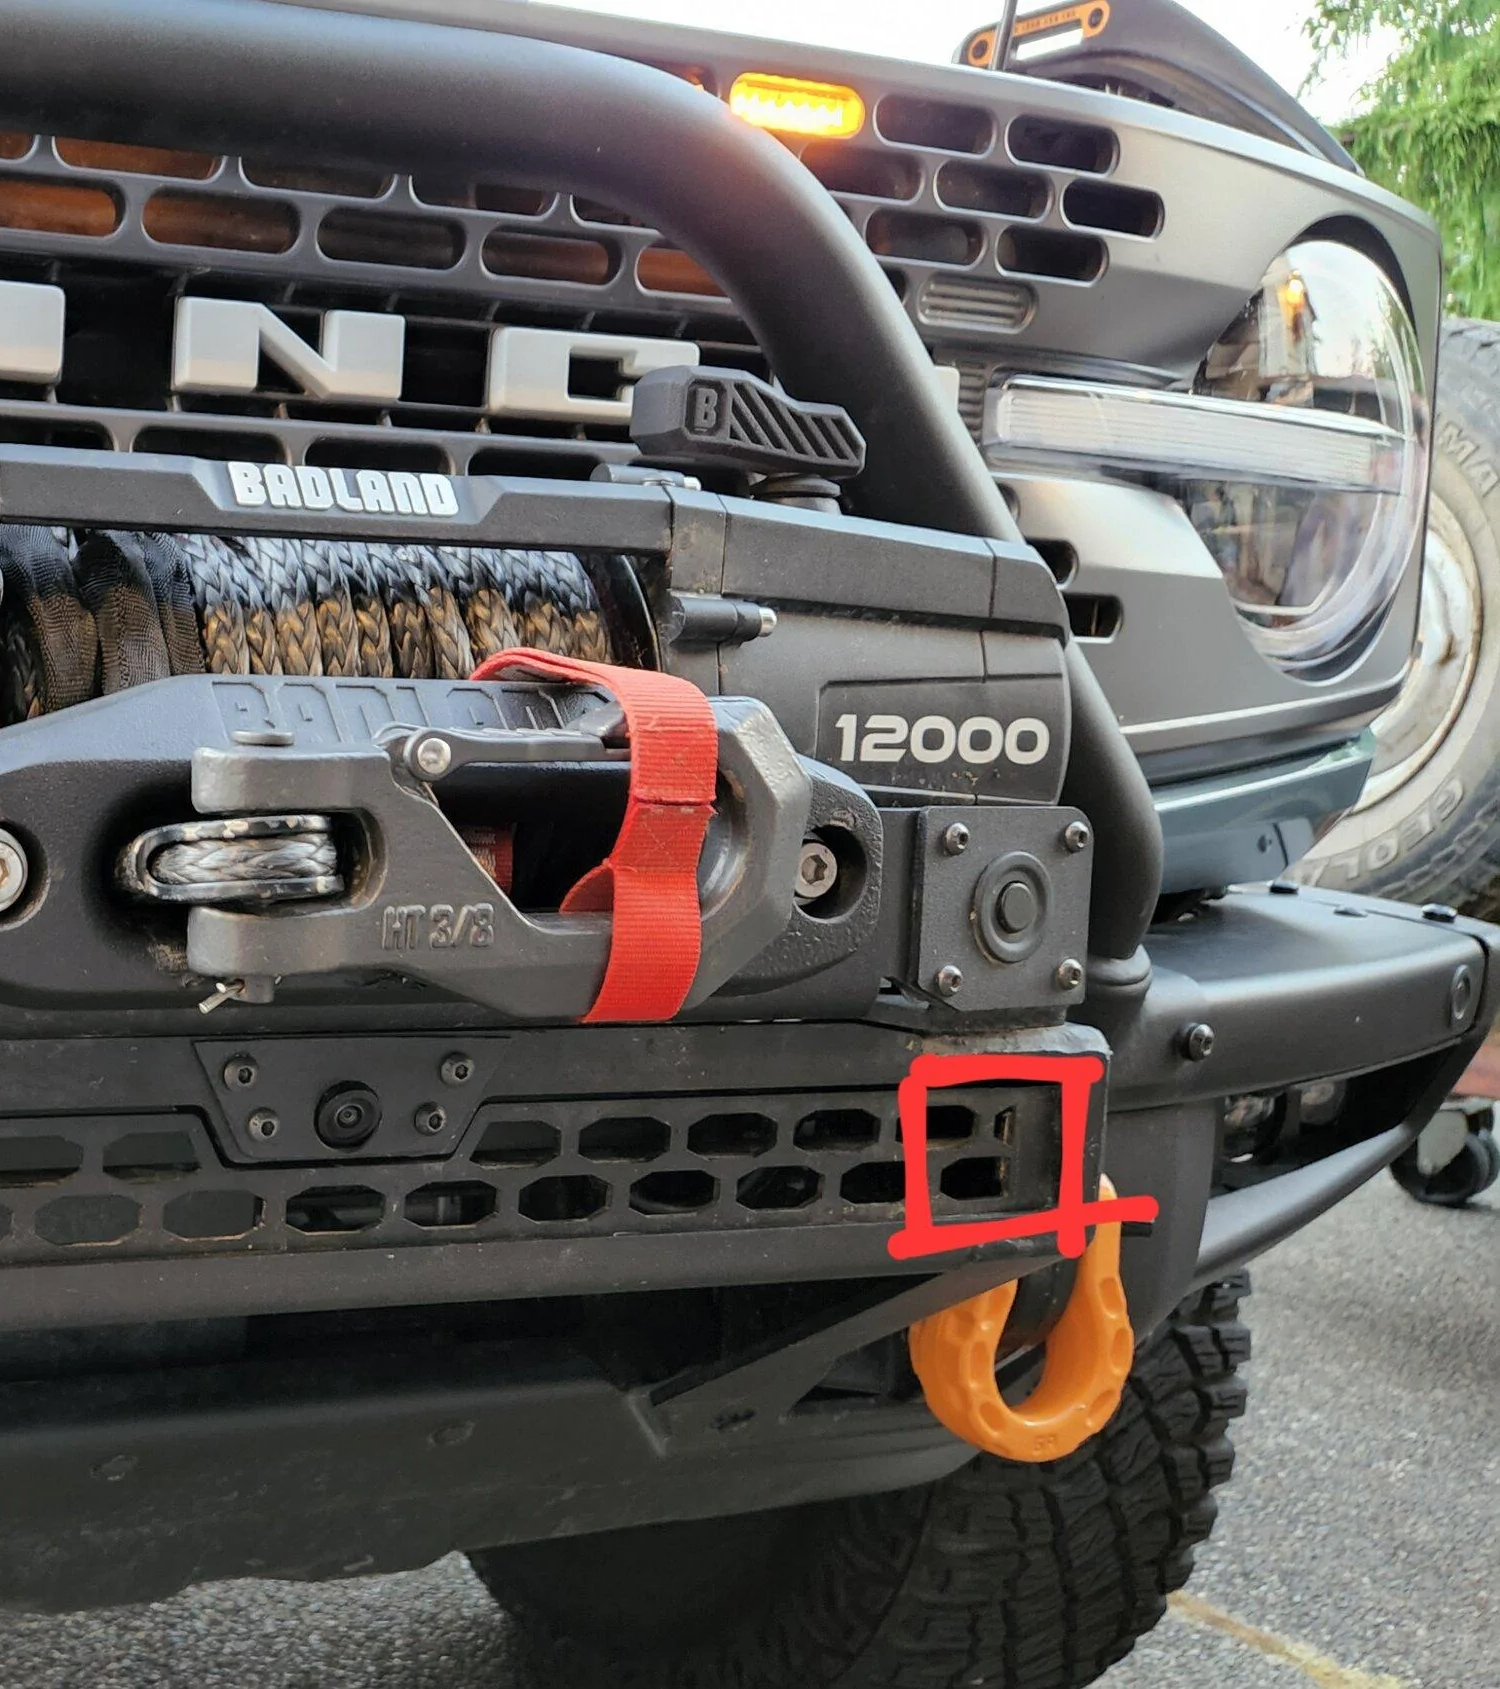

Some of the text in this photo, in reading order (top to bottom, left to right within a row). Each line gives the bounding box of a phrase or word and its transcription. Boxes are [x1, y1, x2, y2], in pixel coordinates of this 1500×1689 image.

[693, 387, 719, 429] B
[227, 461, 459, 518] BADLAND
[834, 713, 1050, 766] 12000
[381, 902, 495, 951] HT 3/8
